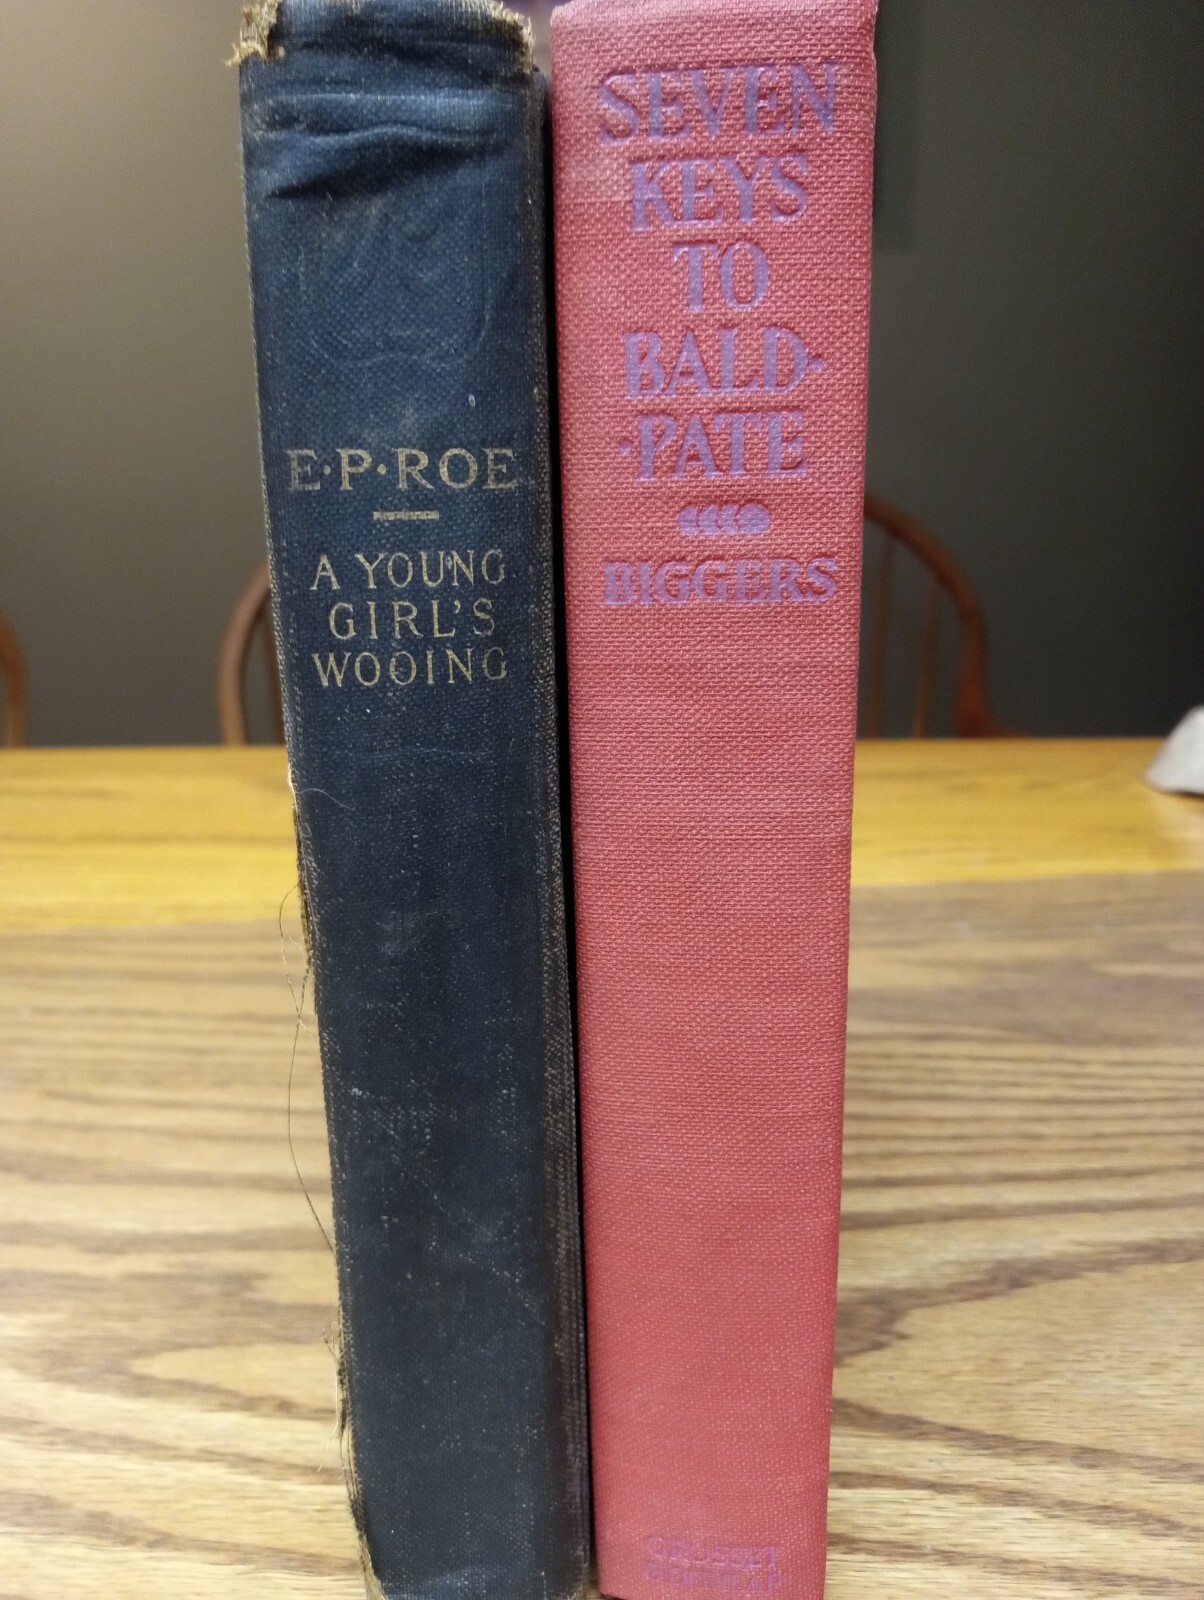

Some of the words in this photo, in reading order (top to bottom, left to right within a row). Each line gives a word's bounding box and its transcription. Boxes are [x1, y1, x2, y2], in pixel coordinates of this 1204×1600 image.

[600, 60, 839, 147] SEVEN
[629, 152, 808, 233] KEYS
[672, 242, 771, 315] TO
[309, 554, 341, 591] A
[354, 549, 506, 590] YOUNG
[603, 557, 838, 606] BIGGERS
[328, 597, 496, 641] GIRL'S
[311, 646, 508, 688] WOOING
